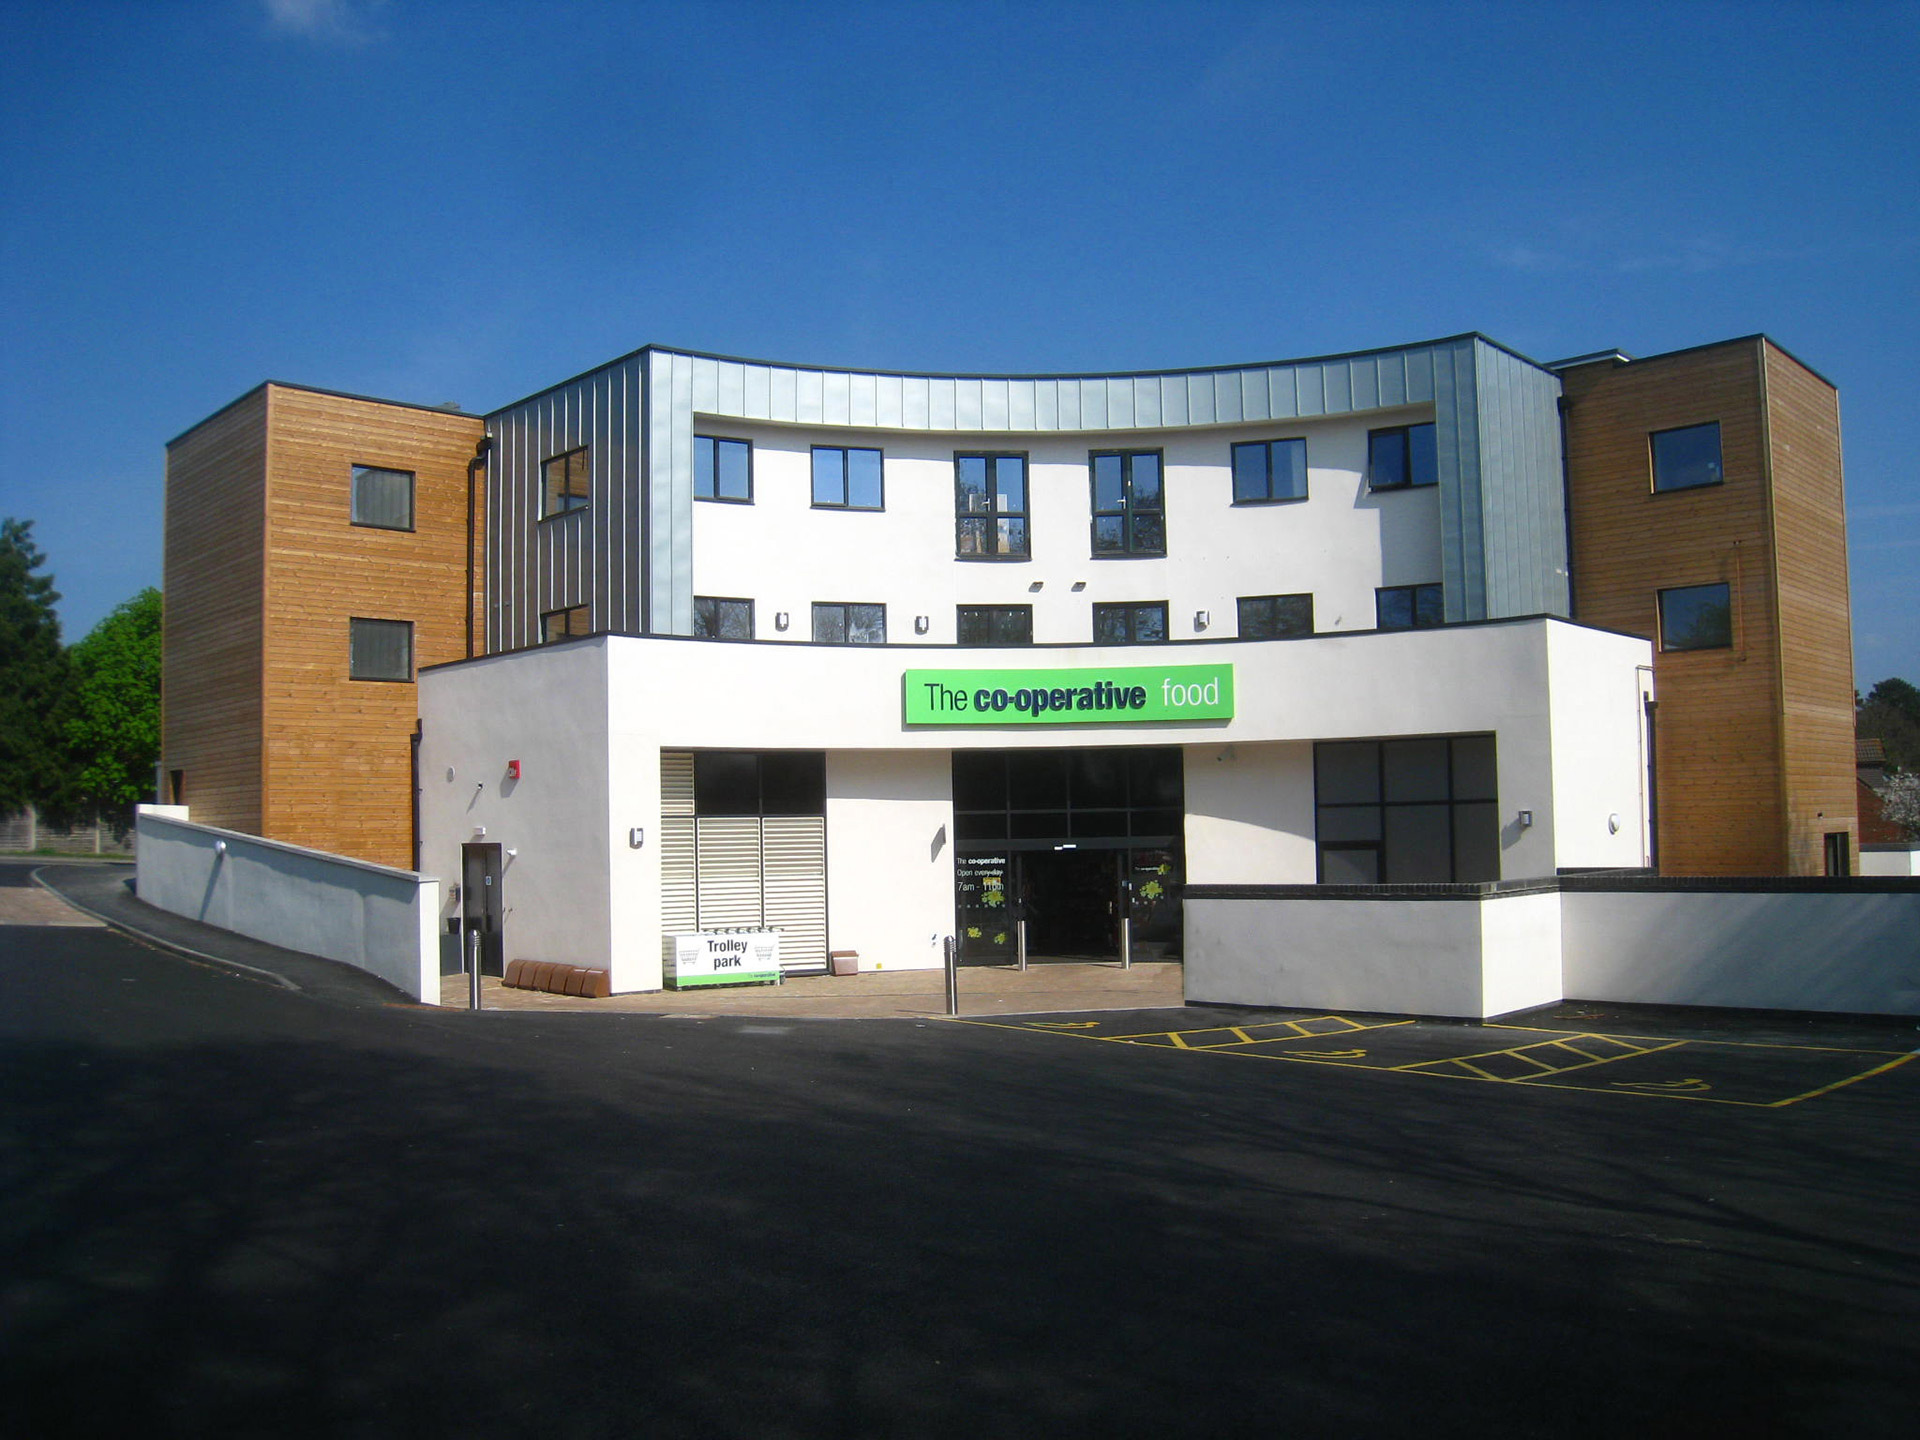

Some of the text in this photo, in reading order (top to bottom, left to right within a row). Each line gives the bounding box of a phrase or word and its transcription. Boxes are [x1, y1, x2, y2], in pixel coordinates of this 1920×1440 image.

[924, 676, 1220, 717] The co-operative food
[968, 857, 1005, 865] co-operative
[957, 868, 973, 877] Open
[957, 881, 975, 891] 7am
[707, 939, 748, 954] Trolley
[713, 955, 742, 971] park
